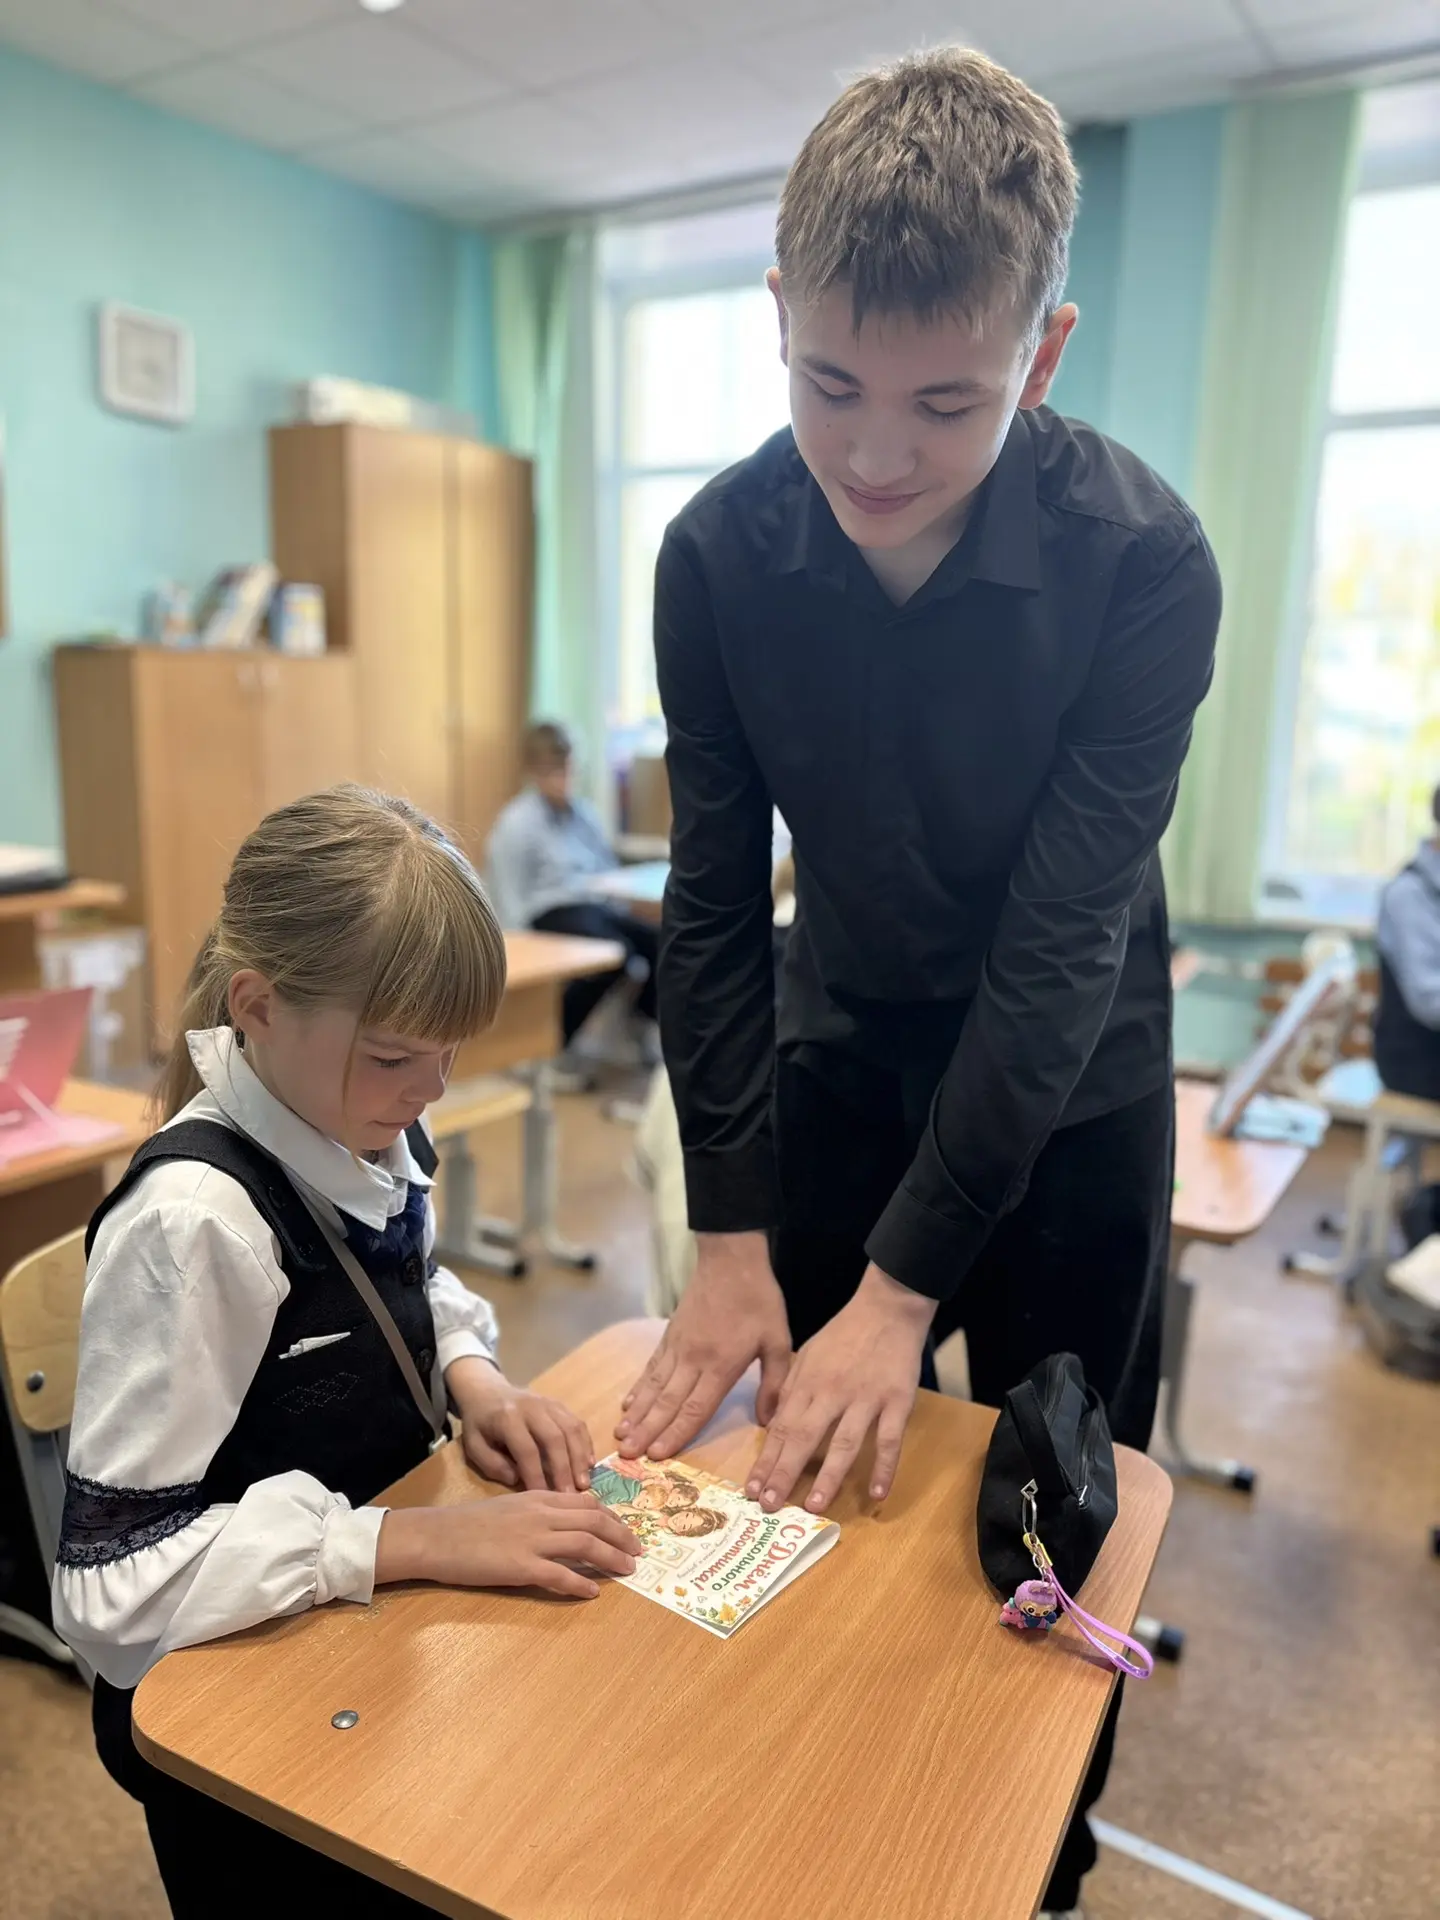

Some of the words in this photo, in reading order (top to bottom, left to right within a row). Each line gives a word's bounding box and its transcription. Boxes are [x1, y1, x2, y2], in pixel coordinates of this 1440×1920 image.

[689, 1518, 761, 1591] работника!
[712, 1517, 780, 1591] дошкольного
[780, 1524, 806, 1539] С
[733, 1541, 797, 1591] Днём
